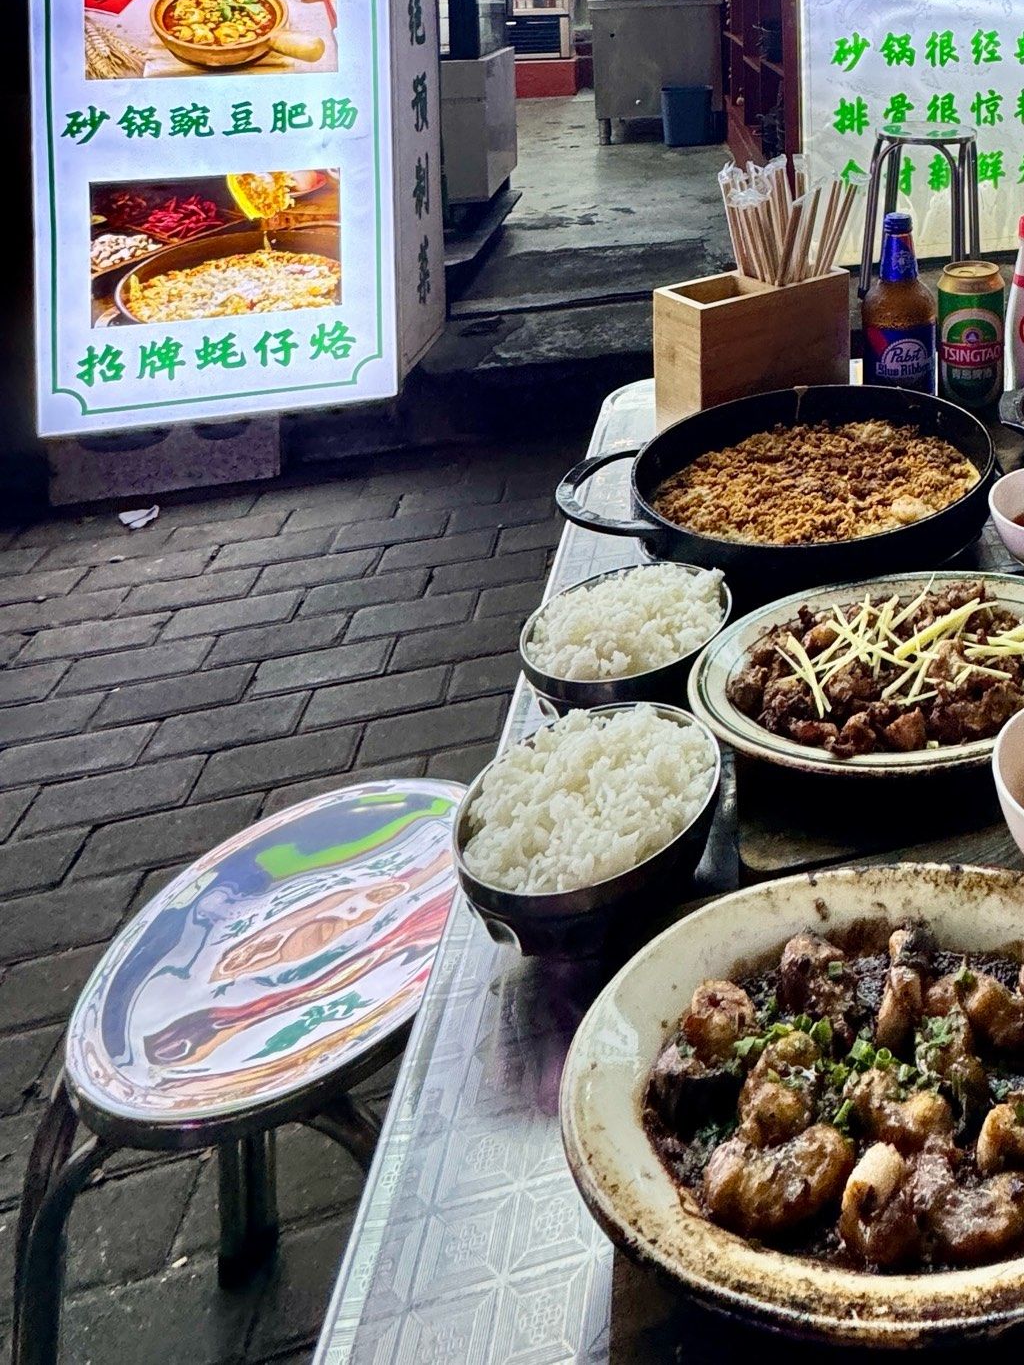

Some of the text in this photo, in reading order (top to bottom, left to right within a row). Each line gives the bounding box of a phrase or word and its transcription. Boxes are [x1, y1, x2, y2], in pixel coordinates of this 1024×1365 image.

[60, 97, 360, 146] 砂锅豌豆肥肠
[75, 319, 358, 389] 招牌蚝仔烙
[889, 346, 922, 364] Pabst
